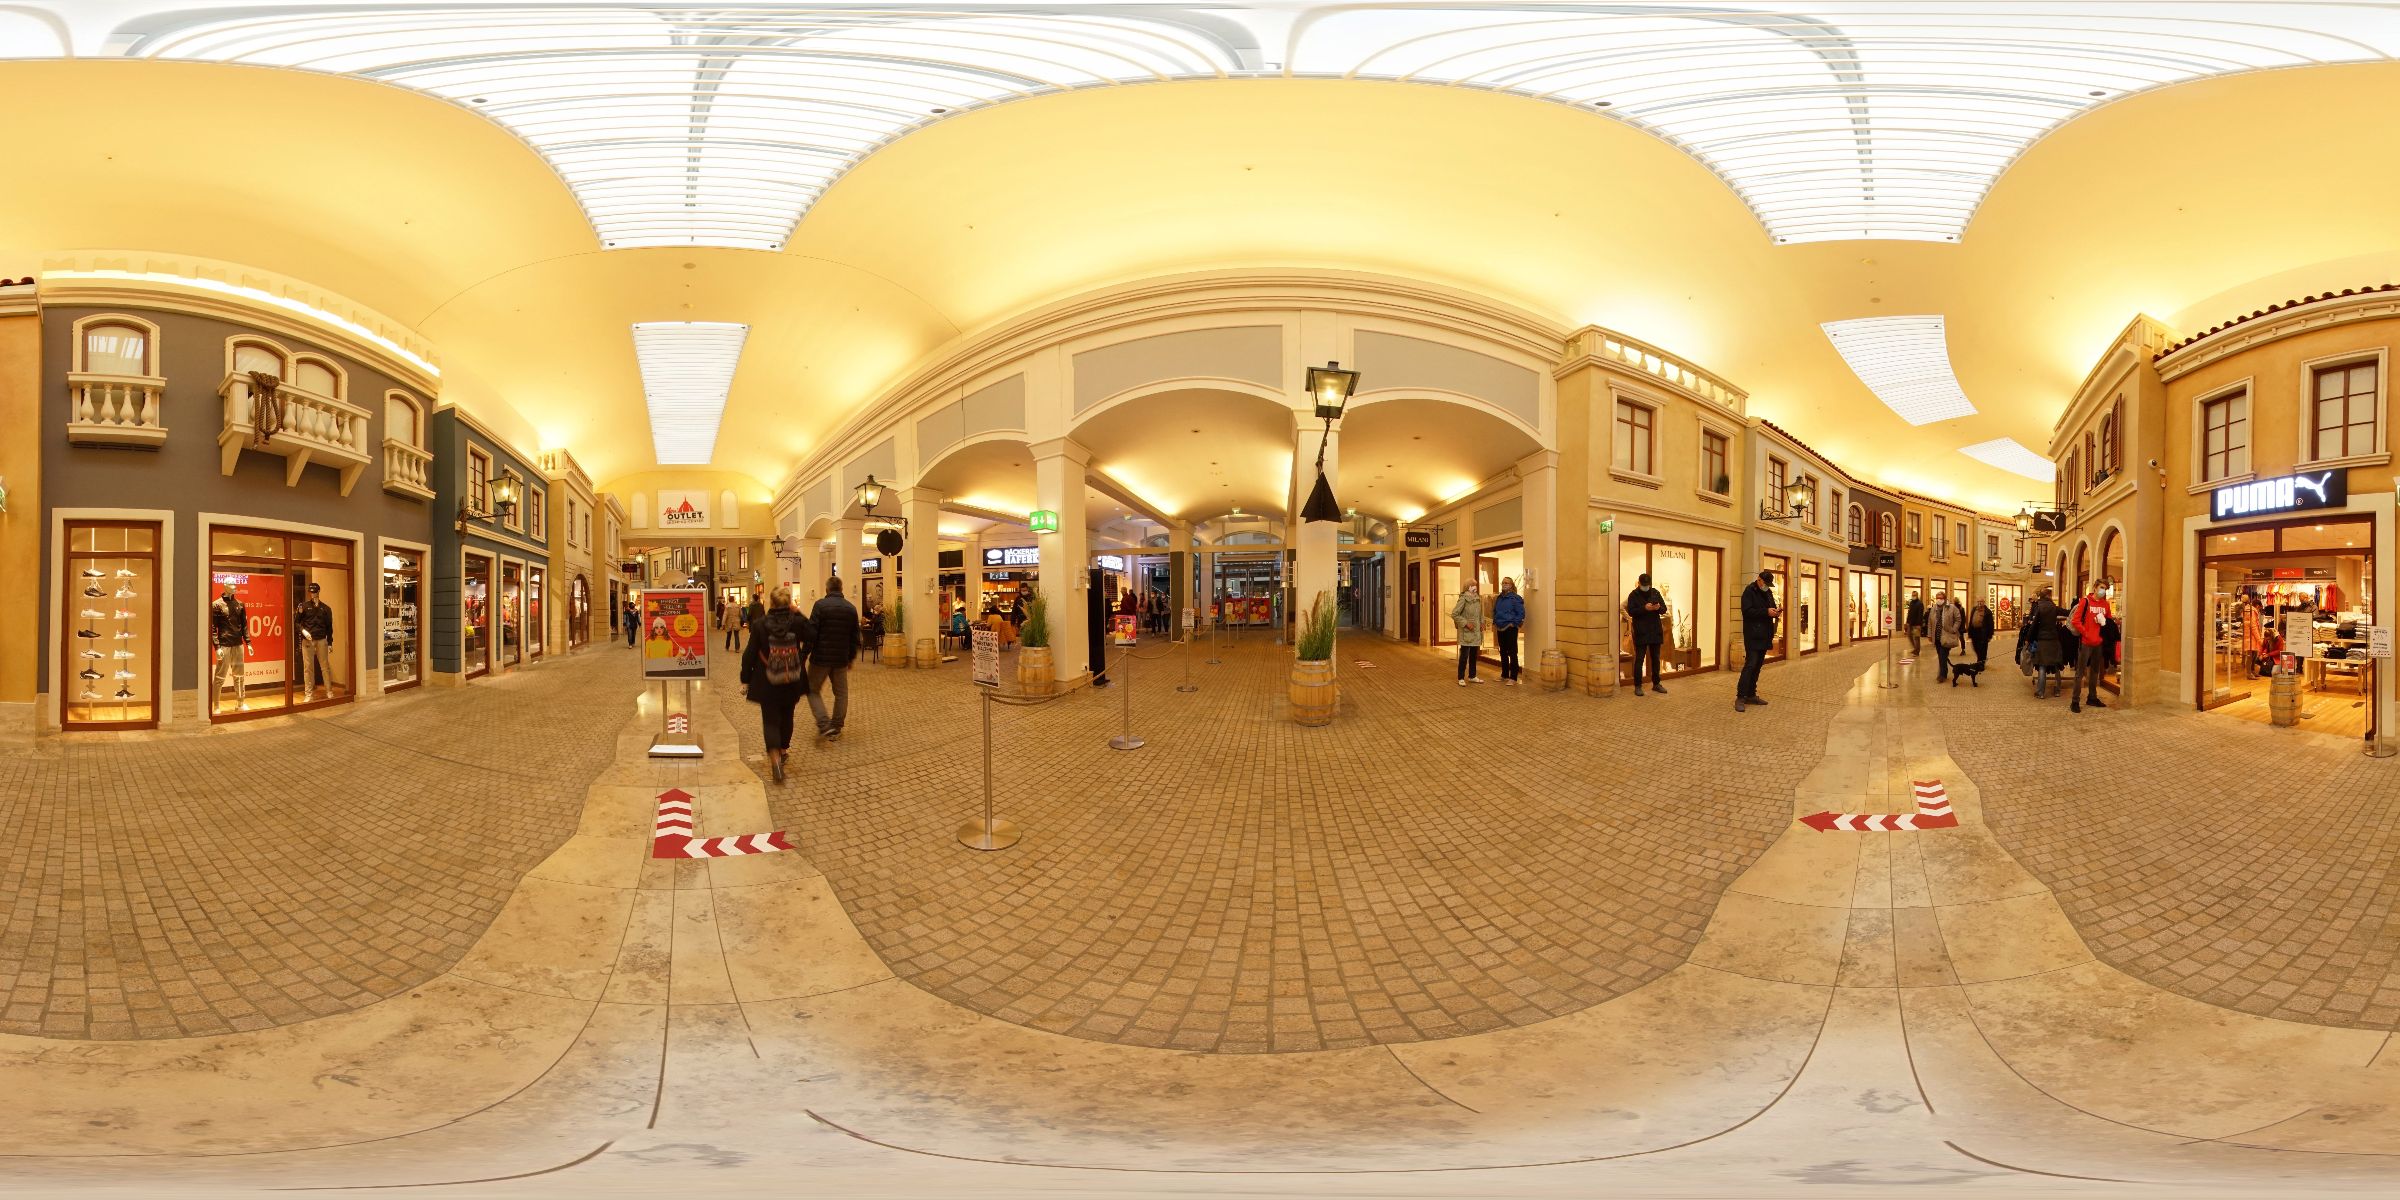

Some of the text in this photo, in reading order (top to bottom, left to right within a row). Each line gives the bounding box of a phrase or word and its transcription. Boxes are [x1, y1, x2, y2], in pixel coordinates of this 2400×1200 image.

[2217, 477, 2295, 517] PUMA
[667, 511, 703, 520] OUTLET
[1004, 554, 1039, 564] HAFERK
[1660, 549, 1686, 560] MILANI
[246, 614, 282, 638] 0%
